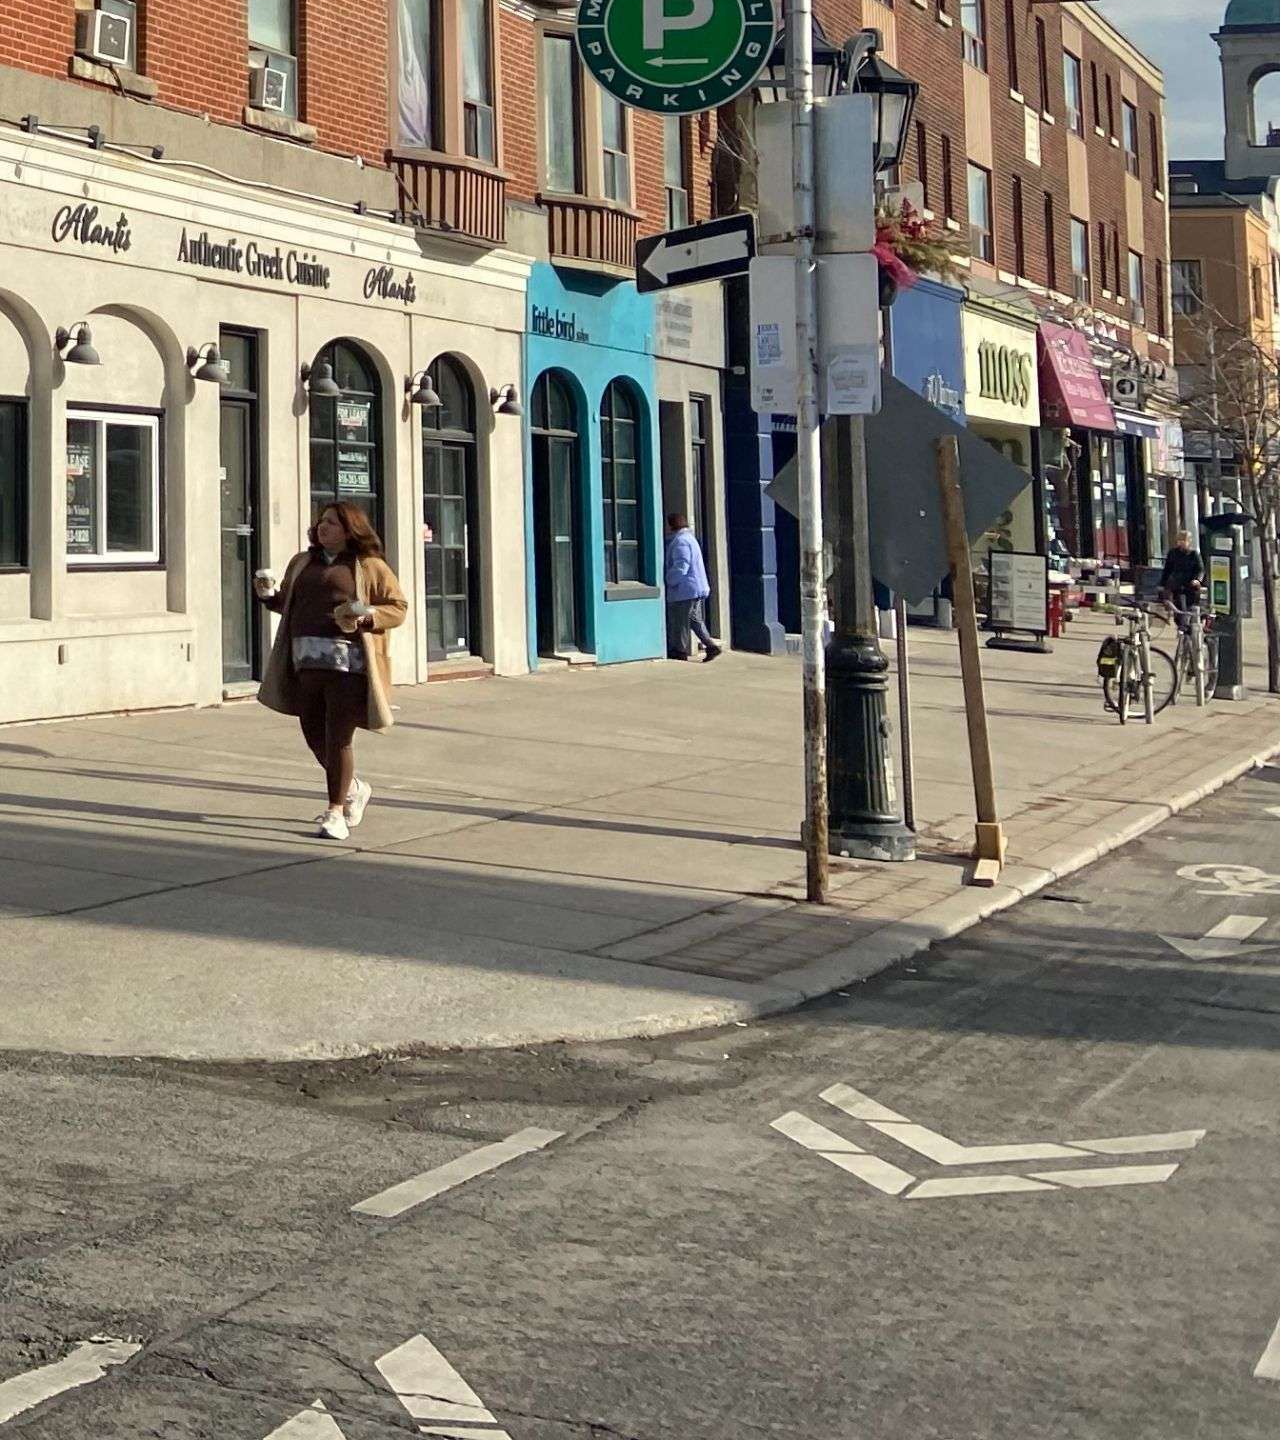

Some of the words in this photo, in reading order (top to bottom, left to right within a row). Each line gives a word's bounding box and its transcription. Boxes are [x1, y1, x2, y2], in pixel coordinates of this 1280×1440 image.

[586, 40, 762, 107] PARKING
[51, 203, 132, 255] Atlantis
[176, 226, 244, 274] Authentic
[245, 241, 285, 281] Greek
[286, 249, 331, 290] Cuisine
[363, 265, 417, 306] Atlantis
[532, 303, 555, 336] little
[555, 308, 576, 342] bird
[977, 337, 1033, 409] moss
